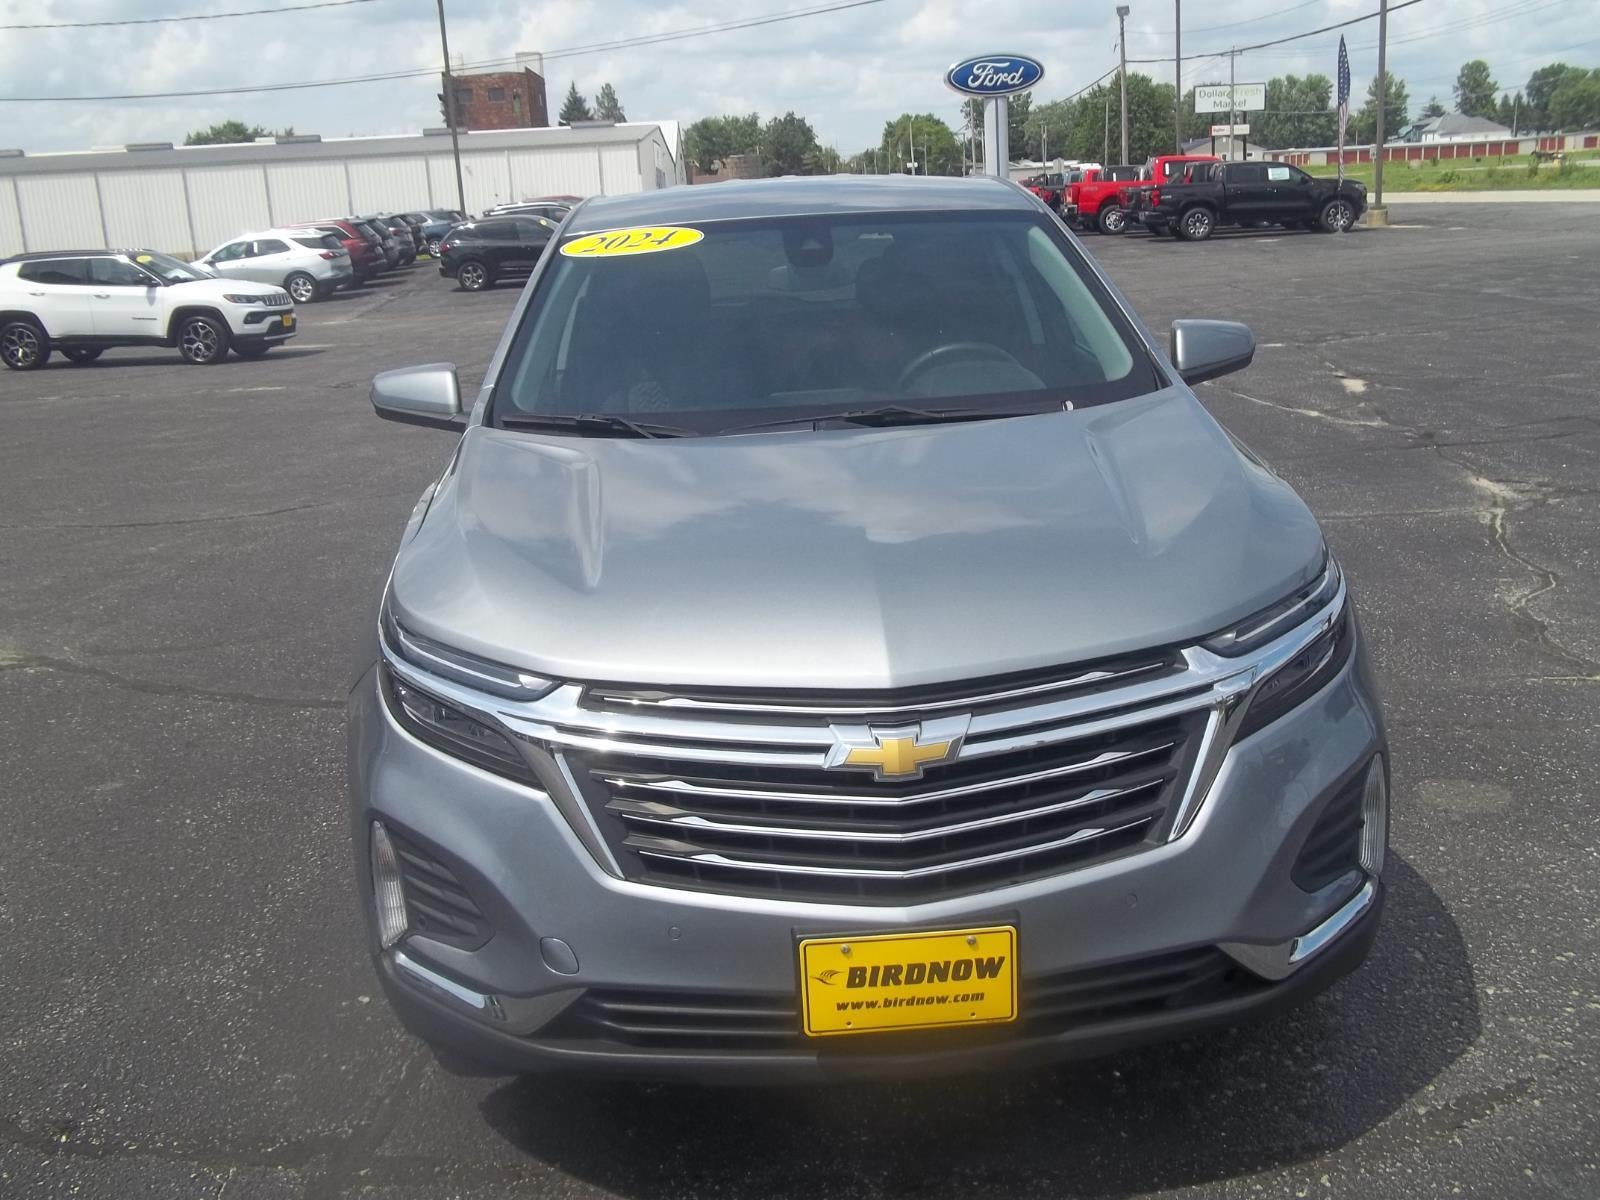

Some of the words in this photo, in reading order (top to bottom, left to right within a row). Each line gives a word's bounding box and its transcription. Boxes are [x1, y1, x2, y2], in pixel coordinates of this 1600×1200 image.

[968, 62, 1024, 88] Ford
[1199, 89, 1227, 99] Dollar
[579, 230, 678, 253] 2024
[846, 956, 1005, 988] BIRDNOW
[836, 991, 984, 1011] www.birdnow.com
